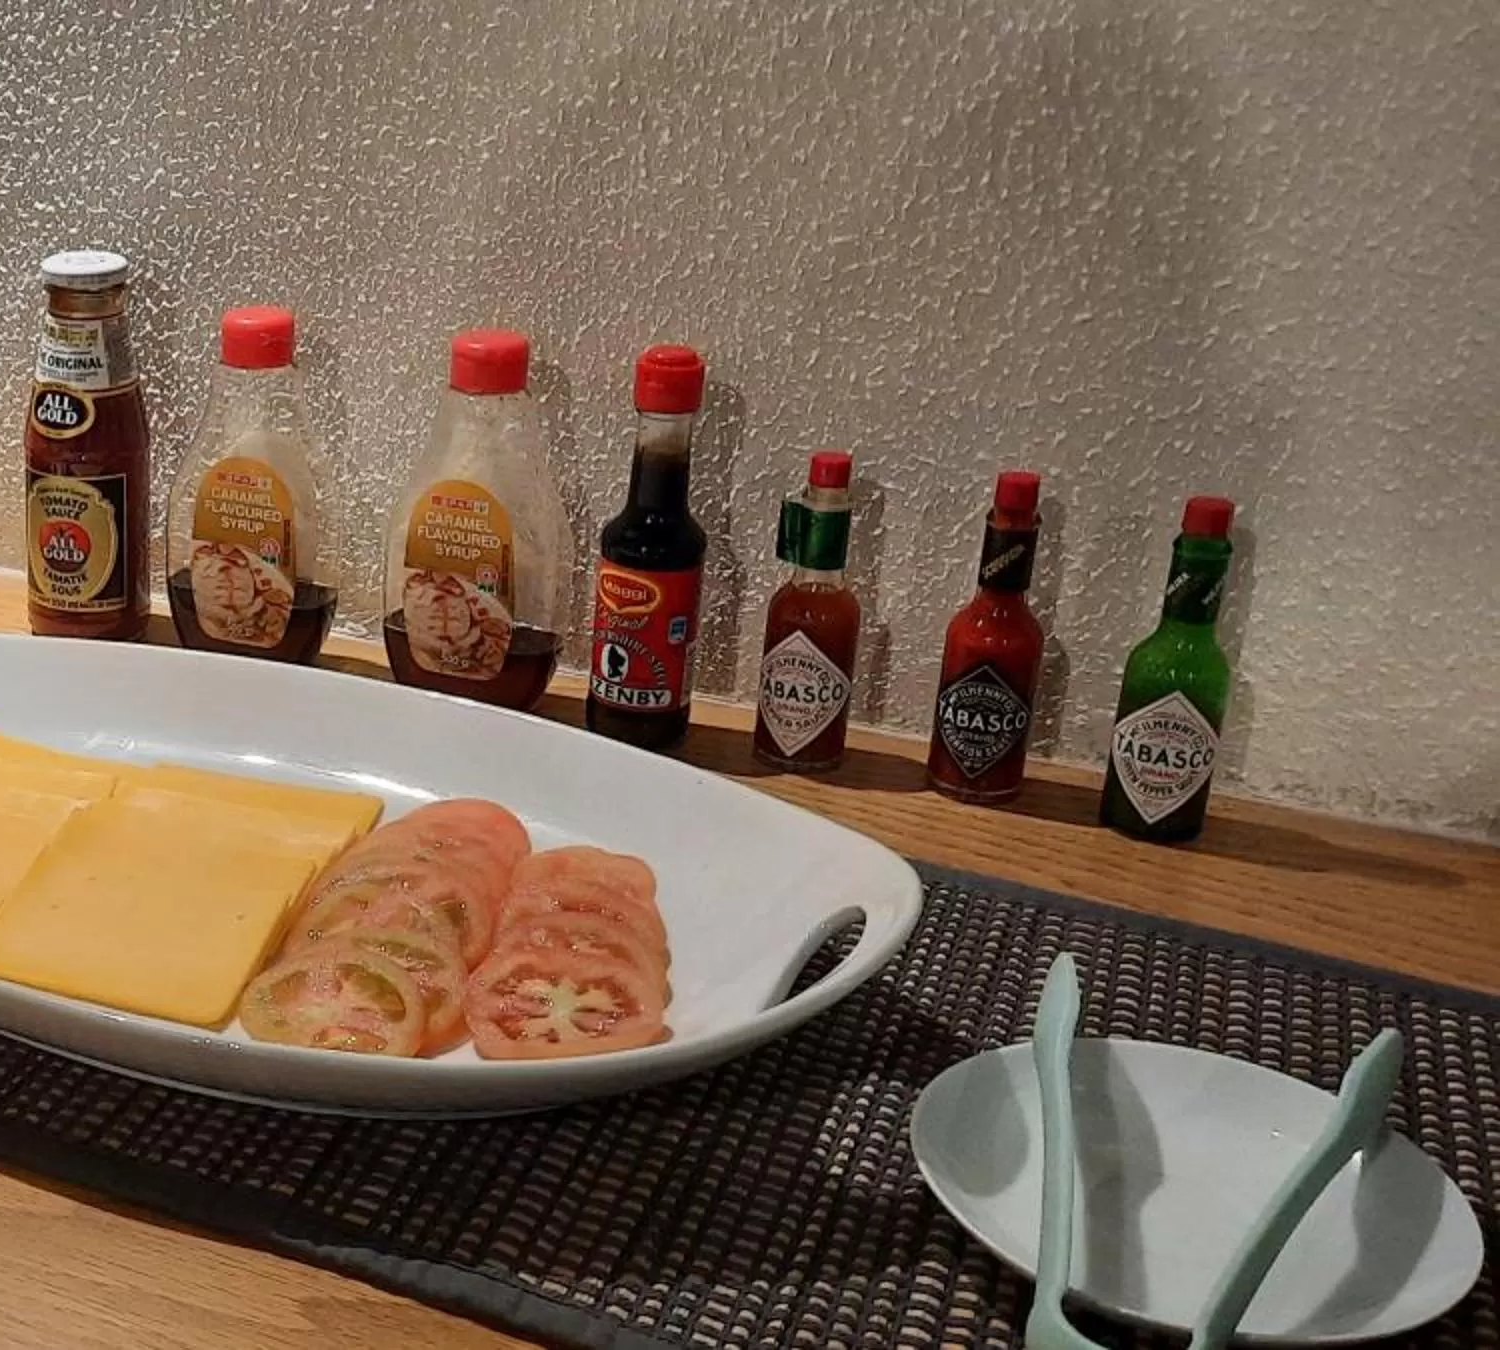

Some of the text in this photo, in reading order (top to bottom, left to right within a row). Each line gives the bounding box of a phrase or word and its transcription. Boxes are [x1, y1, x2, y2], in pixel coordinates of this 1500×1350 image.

[47, 355, 104, 370] ORIGINAL
[44, 393, 73, 411] ALL
[37, 405, 78, 425] GOLD
[40, 494, 89, 512] TOMATO
[211, 486, 276, 508] CARAMEL
[45, 507, 83, 521] SAUCE
[204, 499, 283, 523] FLAVOURED
[220, 516, 265, 535] SYRUP
[425, 511, 494, 533] CARAMEL
[48, 534, 78, 550] ALL
[417, 525, 501, 550] FLAVOURED
[43, 546, 86, 563] GOLD
[434, 542, 482, 560] SYRUP
[51, 584, 83, 597] SOUS
[762, 678, 844, 703] ABASCO
[939, 699, 1028, 733] TABASCO
[1117, 732, 1216, 770] TABASCO
